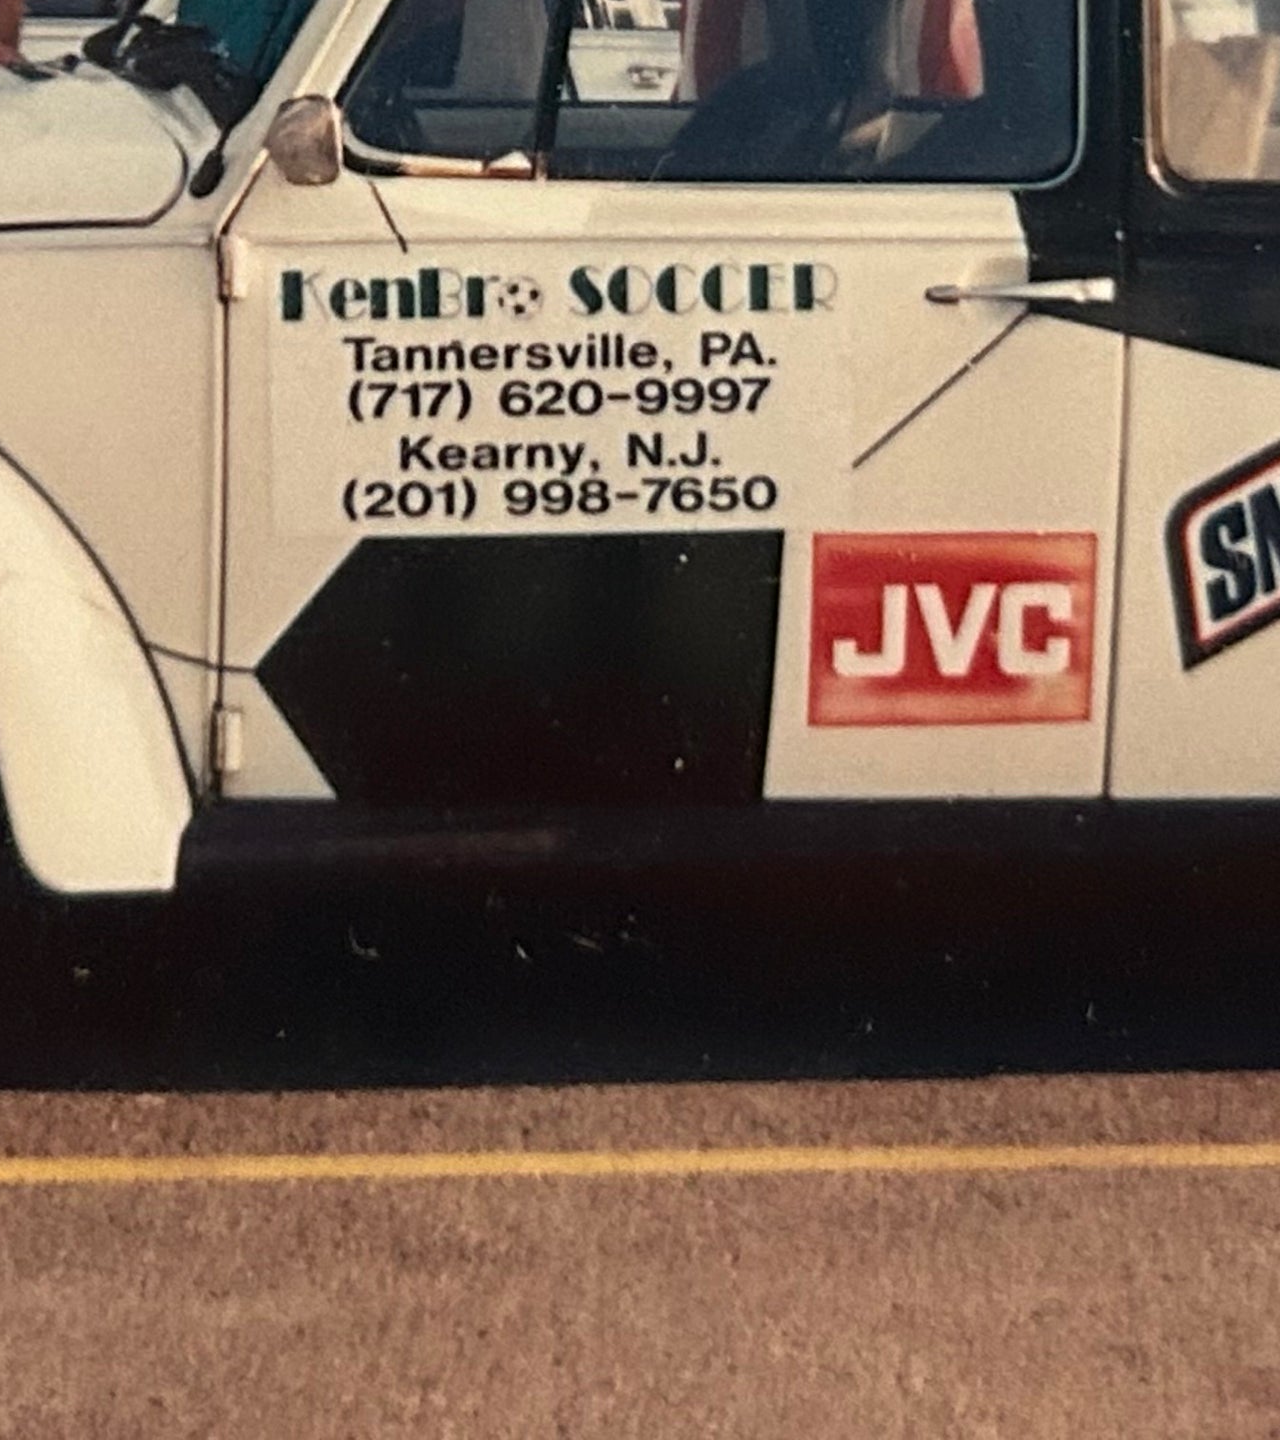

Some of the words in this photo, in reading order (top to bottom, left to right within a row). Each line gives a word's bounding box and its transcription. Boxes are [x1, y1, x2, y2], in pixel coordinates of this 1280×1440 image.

[569, 262, 838, 315] SOCCER
[342, 335, 673, 373] Tannersville,
[700, 331, 777, 367] PA.
[348, 378, 472, 421] (717)
[498, 376, 771, 417] 620-9997
[399, 435, 600, 476] Kearny,
[627, 431, 722, 468] N.J.
[342, 476, 477, 521] (201)
[503, 474, 778, 515] 998-7650
[832, 583, 1071, 678] JVC
